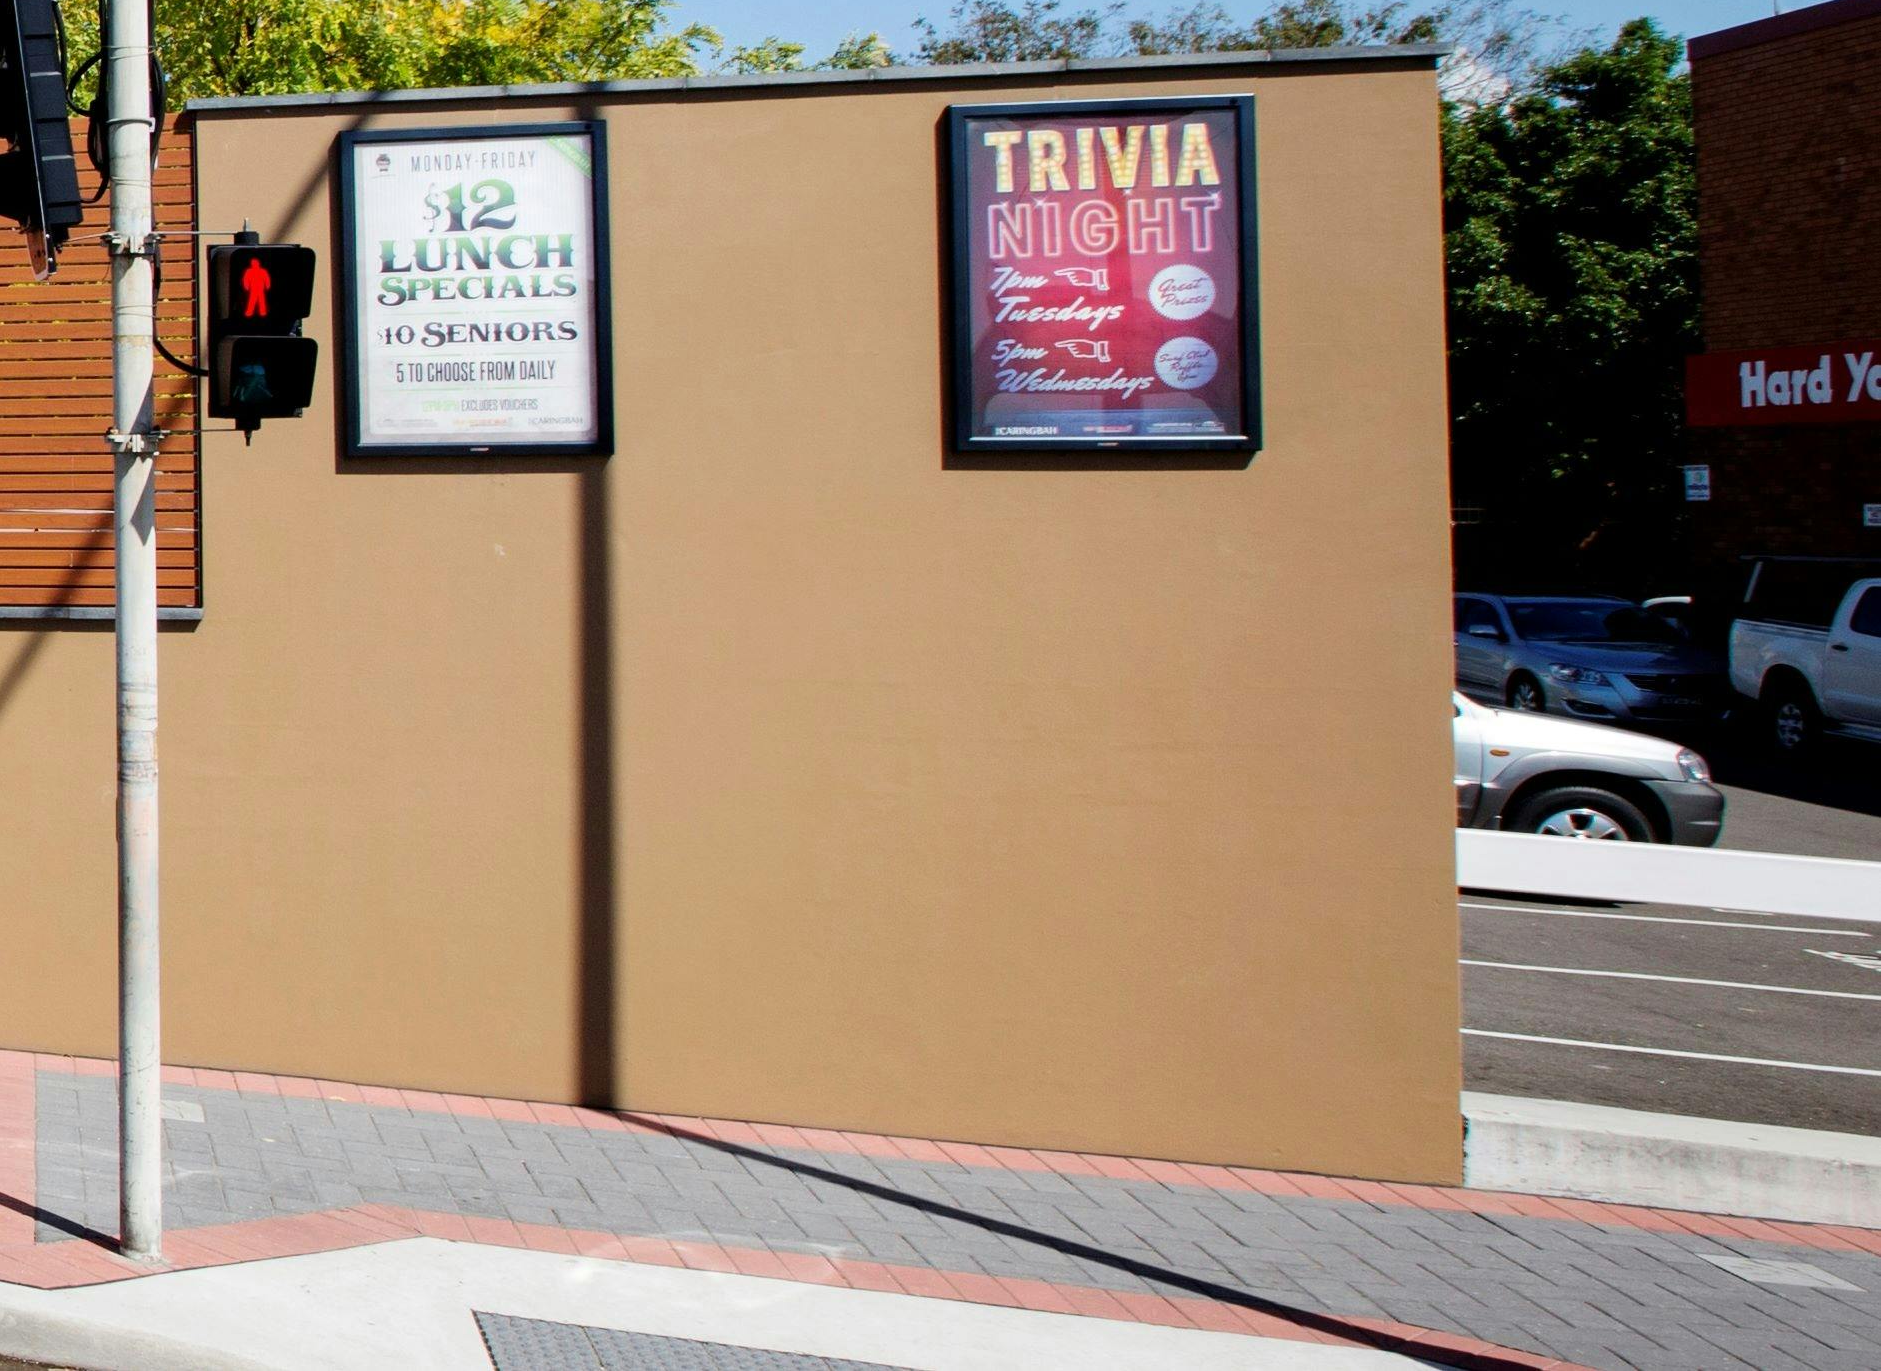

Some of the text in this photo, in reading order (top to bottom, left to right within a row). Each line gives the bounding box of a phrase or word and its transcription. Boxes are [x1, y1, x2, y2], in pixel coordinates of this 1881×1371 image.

[983, 123, 1221, 193] TRIVIA
[423, 178, 517, 232] $12
[988, 196, 1222, 259] NIGHT
[378, 233, 574, 273] LUNCH
[377, 274, 577, 306] SPECIALS
[991, 267, 1048, 297] 7pm
[1158, 278, 1207, 295] Great
[995, 296, 1125, 331] Tuesdays
[421, 321, 578, 347] SENIORS
[991, 339, 1048, 367] 5pm
[396, 360, 556, 382] 5 TO CHOOSE FROM DAILY
[995, 368, 1155, 400] Wednesdays
[1739, 354, 1833, 408] Hard
[461, 399, 498, 412] EXCLUDES
[500, 398, 539, 411] VOUCHERS
